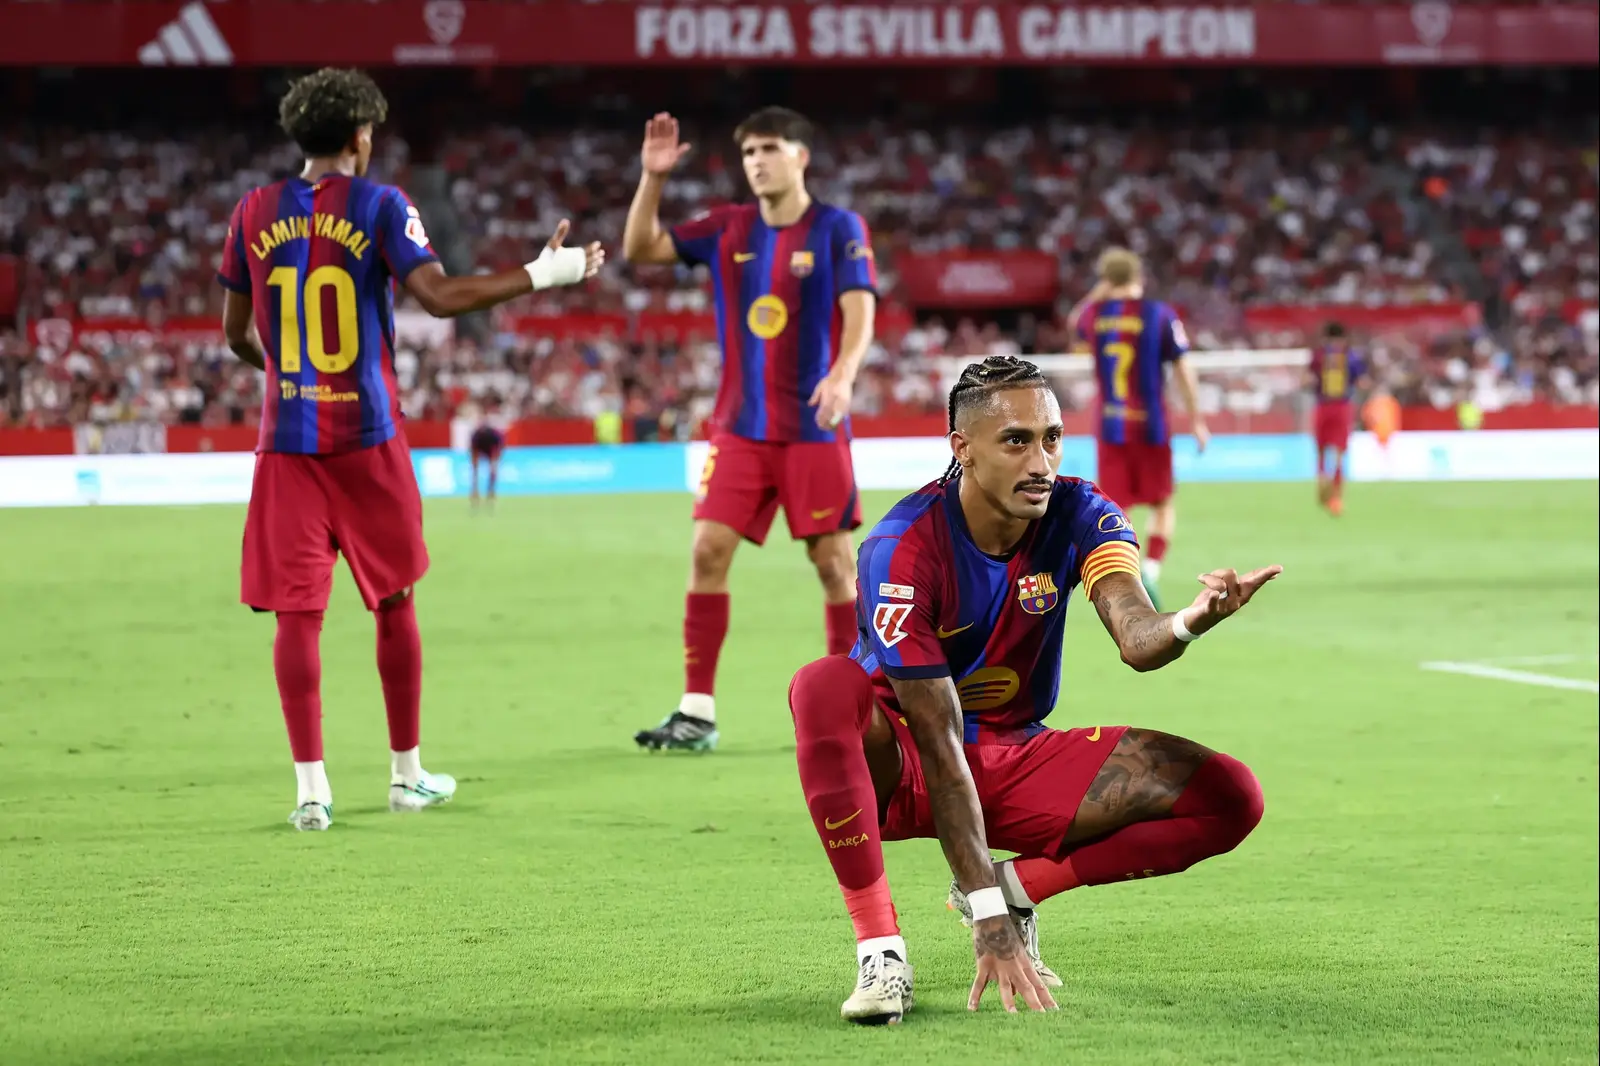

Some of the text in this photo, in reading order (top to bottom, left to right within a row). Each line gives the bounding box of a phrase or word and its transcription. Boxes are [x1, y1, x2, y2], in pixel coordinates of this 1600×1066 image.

[635, 7, 1254, 57] FORZA SEVILLA CAMPEON
[314, 212, 371, 260] YAMAL
[266, 265, 359, 374] 10
[1104, 342, 1134, 399] 7
[829, 832, 869, 849] BARÇA
